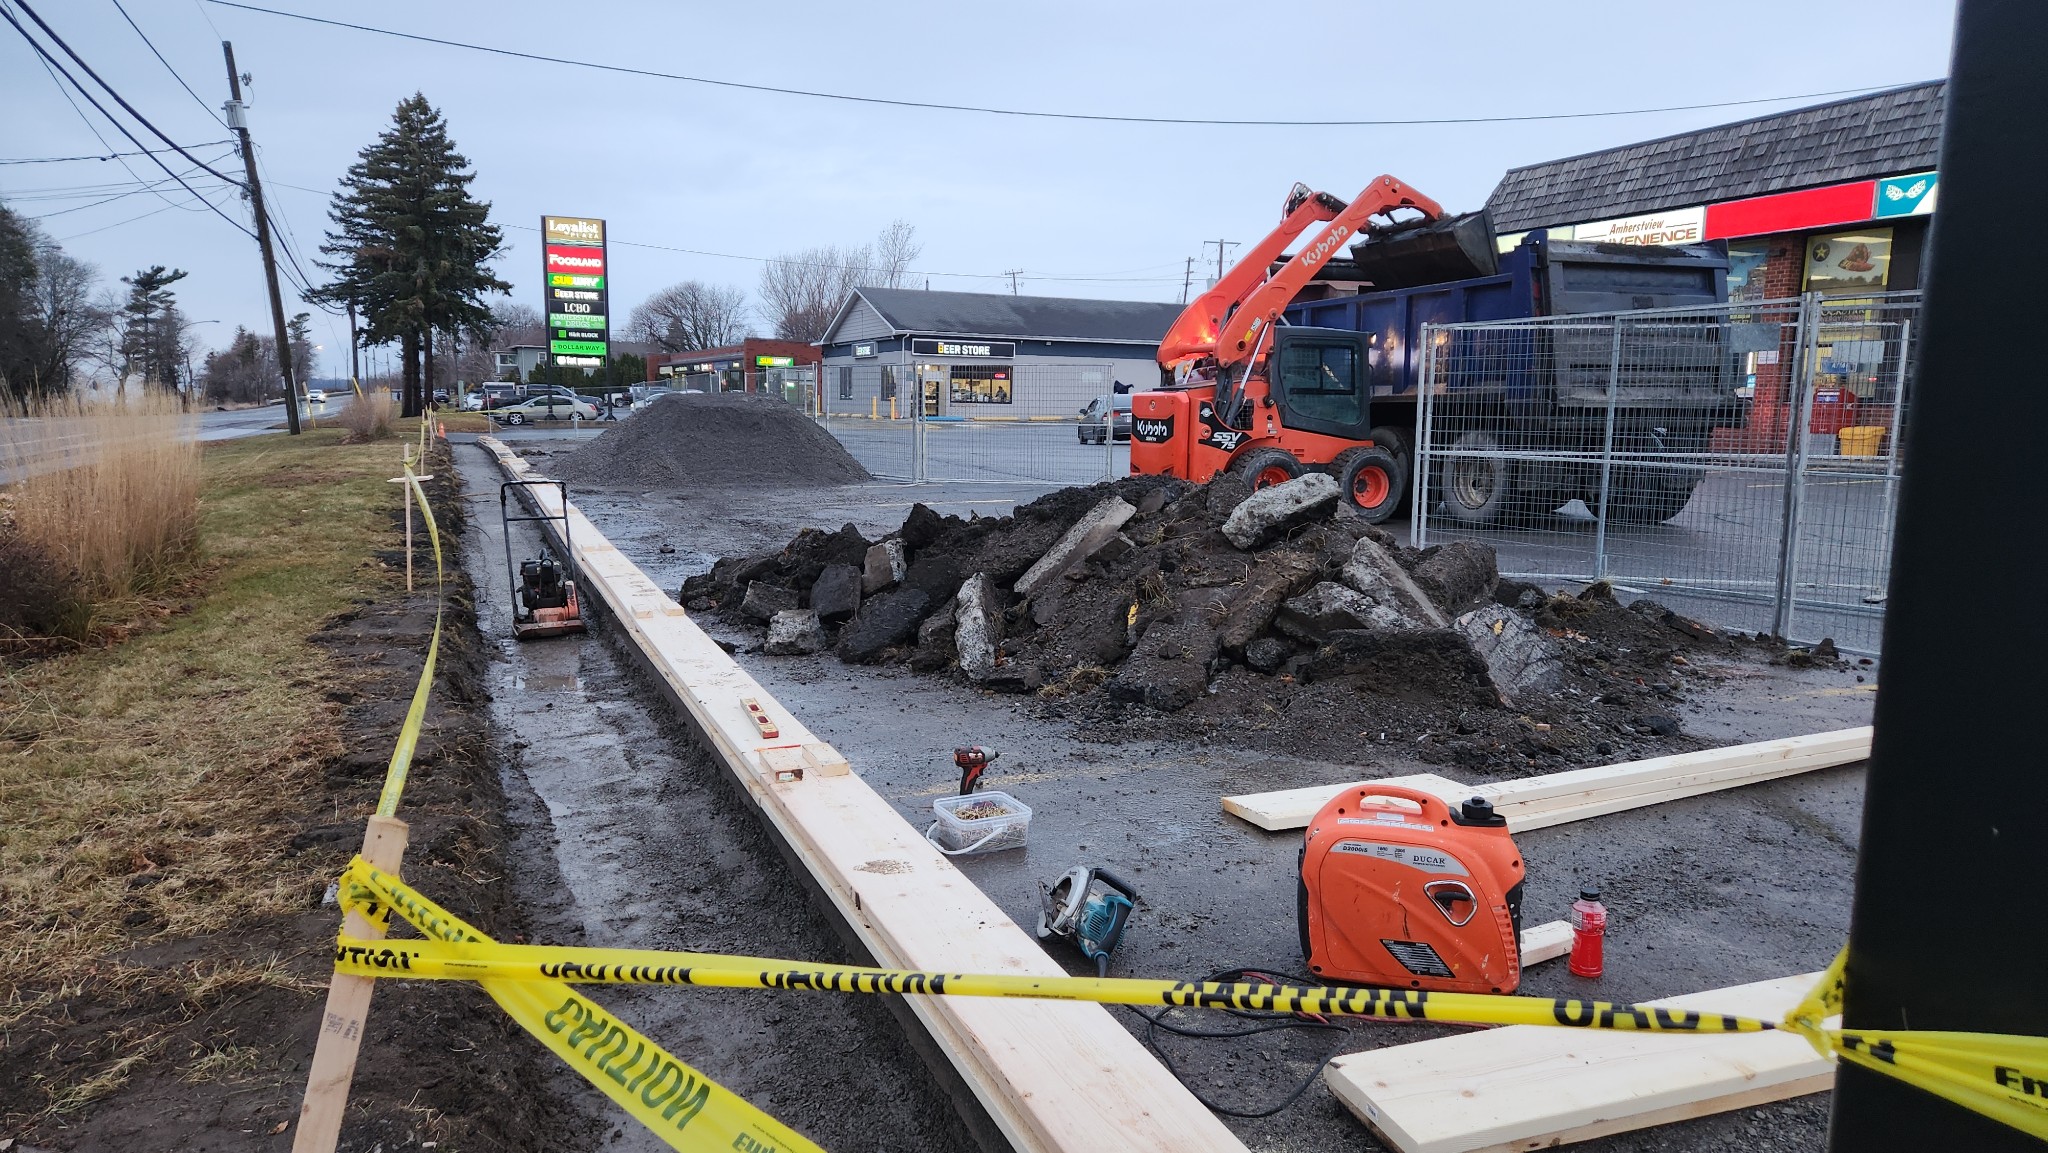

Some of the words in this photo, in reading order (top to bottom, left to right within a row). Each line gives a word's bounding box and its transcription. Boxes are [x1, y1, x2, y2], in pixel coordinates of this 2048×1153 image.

[548, 219, 599, 236] Loyalist
[1609, 219, 1665, 235] Amherstview
[1301, 225, 1349, 266] Kubota
[549, 254, 602, 268] FOODLAND
[552, 275, 600, 287] SUBWAY
[554, 288, 574, 299] BEER
[574, 290, 599, 300] STORE
[564, 302, 591, 313] LCBO
[937, 342, 961, 355] BEER
[961, 344, 991, 356] STORE
[757, 357, 793, 366] SUBWAY
[1137, 420, 1168, 437] Kubota
[1212, 431, 1243, 442] SSV
[1220, 441, 1236, 450] 75
[1413, 855, 1447, 865] DUCAR
